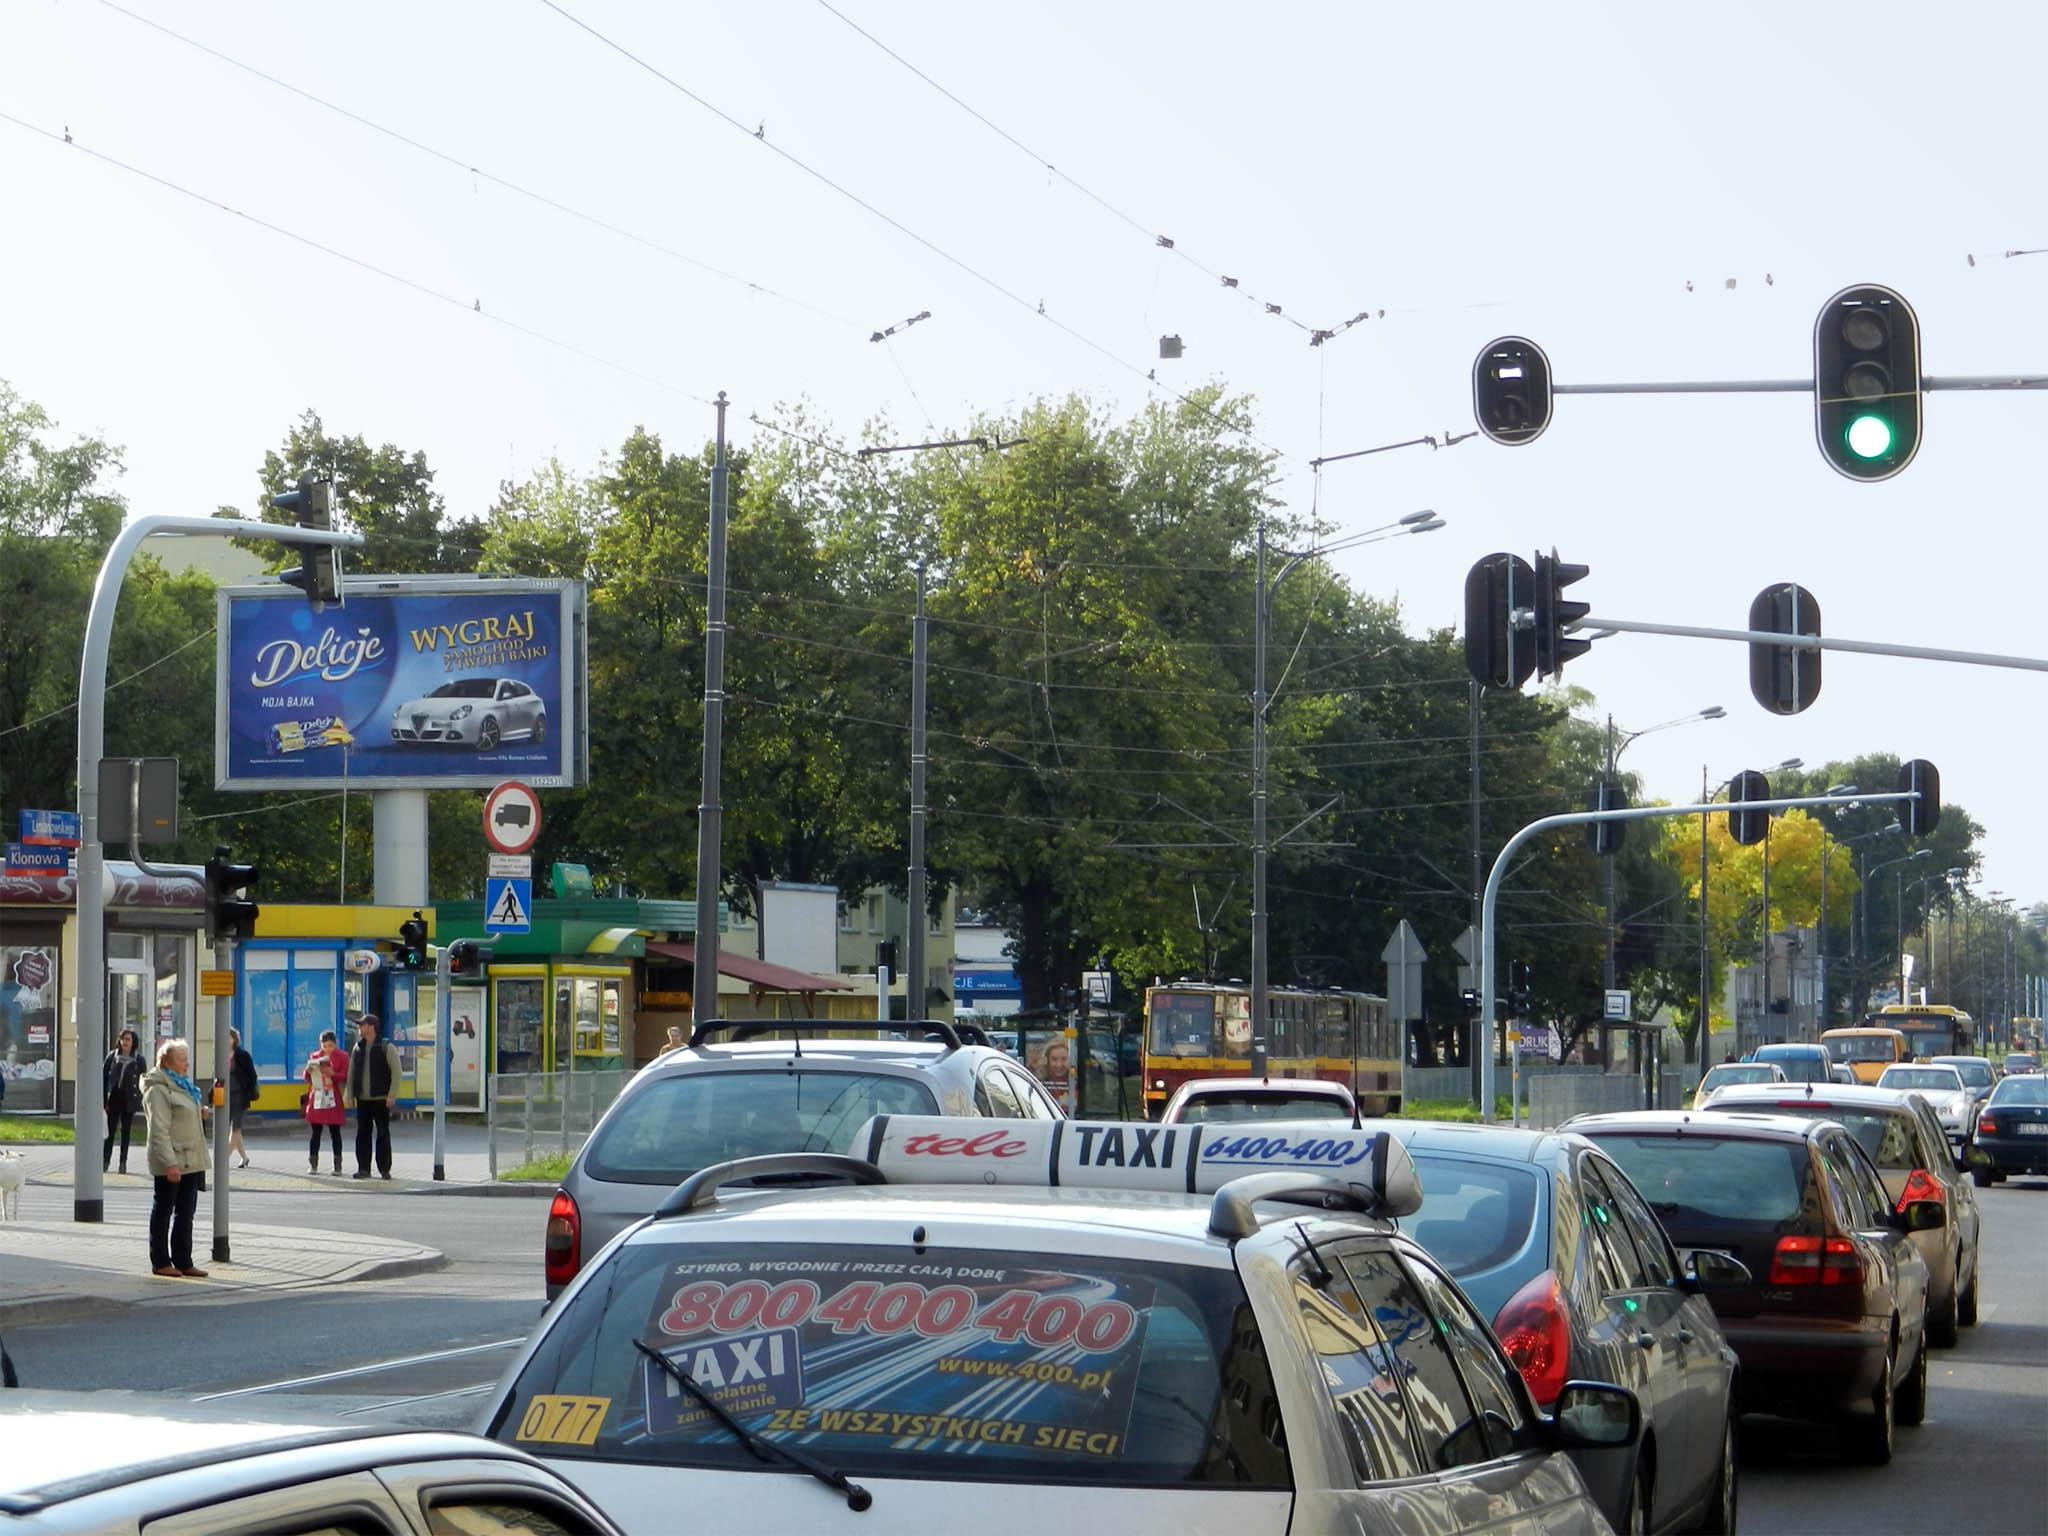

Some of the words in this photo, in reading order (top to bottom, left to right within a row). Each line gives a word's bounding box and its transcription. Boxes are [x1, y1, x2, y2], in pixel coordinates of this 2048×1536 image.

[410, 611, 534, 652] WYGRAJ
[444, 639, 524, 661] SAMOCHÓD
[251, 627, 385, 687] Delicje
[510, 645, 548, 662] BAJKI
[262, 697, 284, 707] MOJA
[287, 696, 315, 707] BAJKA
[11, 851, 60, 865] Klonowa
[904, 1129, 1027, 1158] tele
[1075, 1126, 1177, 1168] TAXI
[1203, 1135, 1355, 1162] 6400-400
[675, 1261, 743, 1275] SZYBKO,
[749, 1261, 840, 1273] WYGODNIE
[852, 1262, 904, 1275] PRZEZ
[909, 1264, 954, 1279] CAŁĄ
[957, 1267, 1007, 1282] DOBĘ
[660, 1279, 822, 1335] 800
[811, 1281, 979, 1338] 400
[971, 1289, 1138, 1354] 400
[656, 1334, 785, 1397] TAXI
[938, 1358, 1113, 1391] www.400.pl
[524, 1402, 602, 1441] 077
[767, 1409, 810, 1430] ZE
[820, 1410, 1027, 1444] WSZYSTKICH
[1033, 1426, 1120, 1456] SIECI
